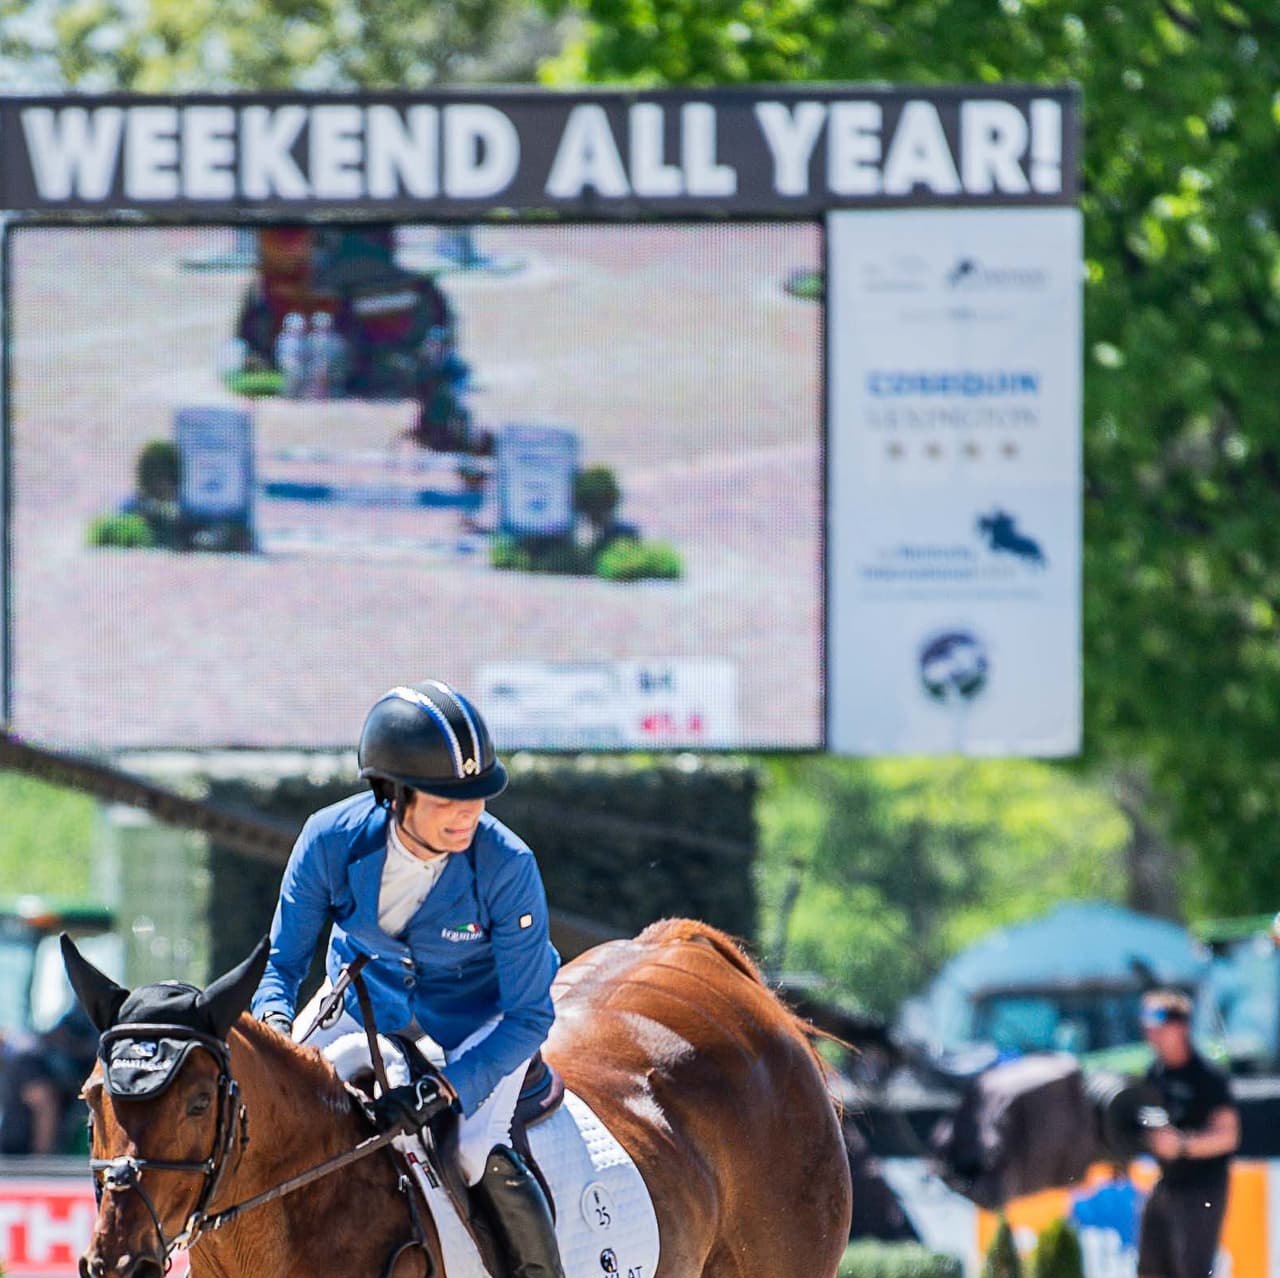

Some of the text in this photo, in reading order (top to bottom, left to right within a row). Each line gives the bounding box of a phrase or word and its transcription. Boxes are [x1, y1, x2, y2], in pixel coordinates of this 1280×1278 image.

[21, 103, 521, 201] WEEKEND
[544, 101, 739, 198] ALL
[753, 98, 1063, 197] YEAR!
